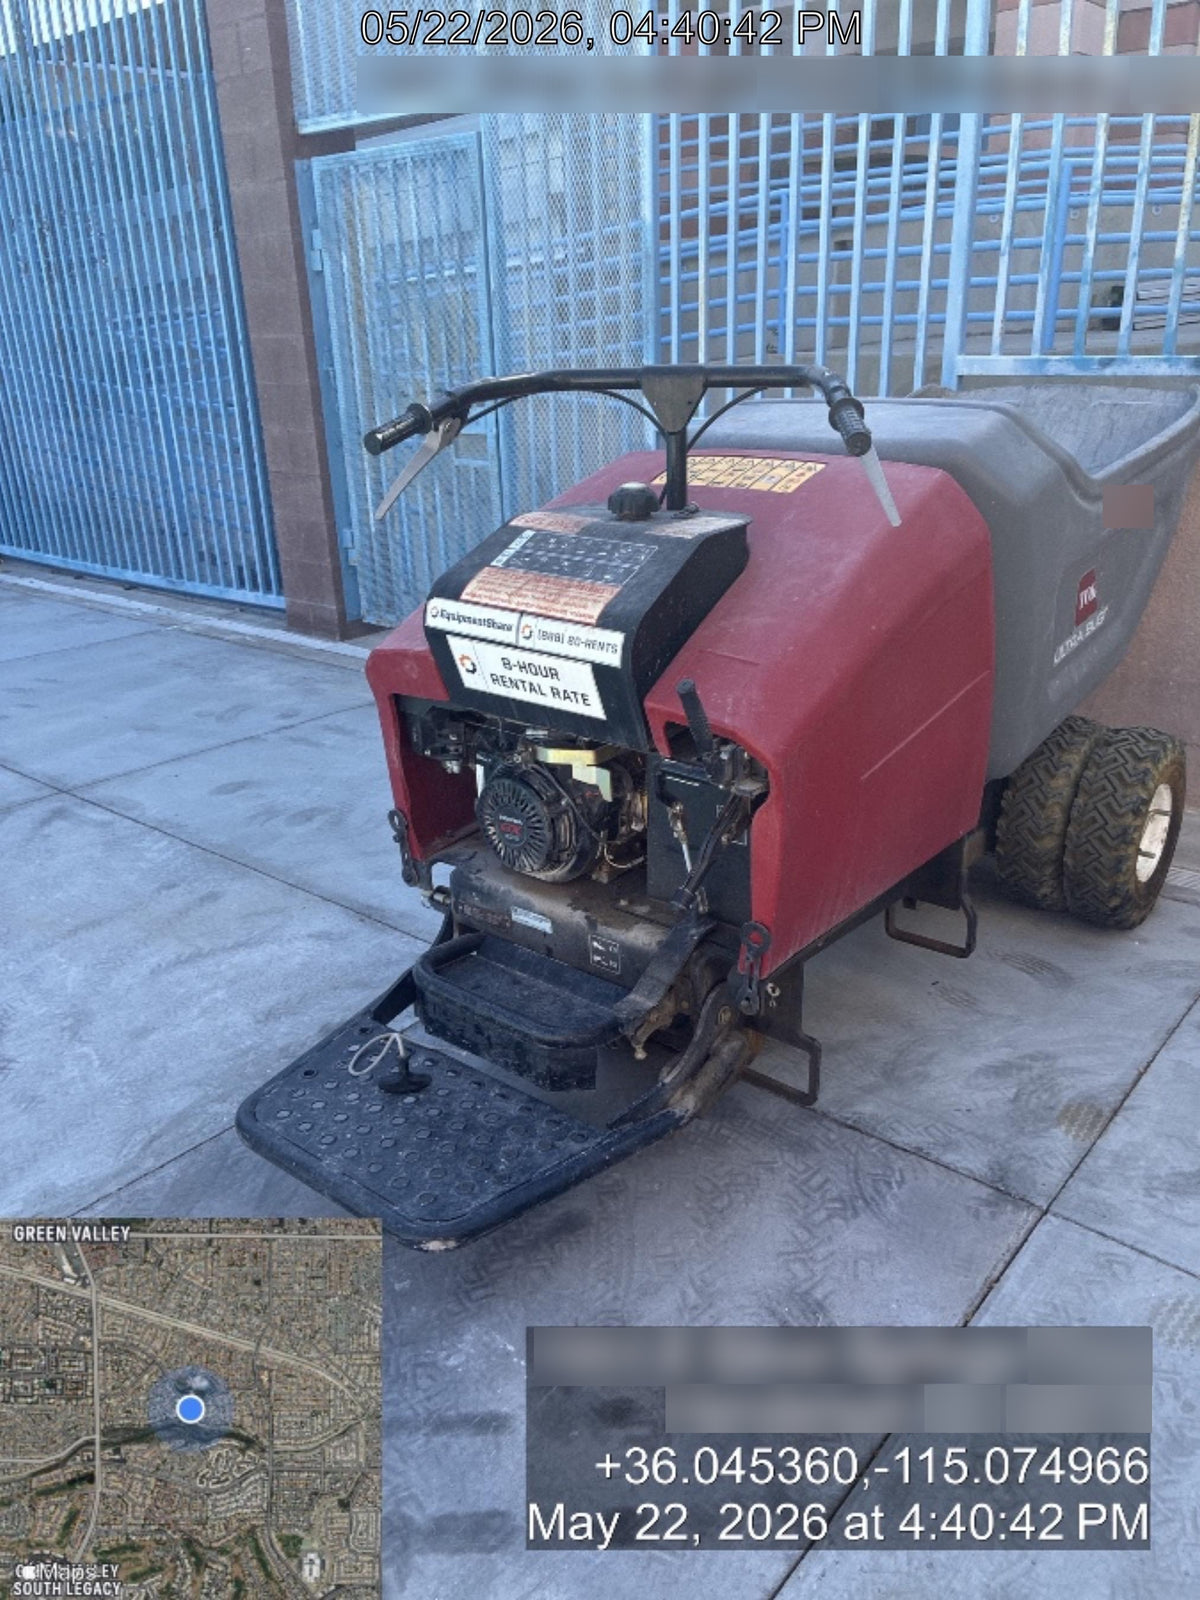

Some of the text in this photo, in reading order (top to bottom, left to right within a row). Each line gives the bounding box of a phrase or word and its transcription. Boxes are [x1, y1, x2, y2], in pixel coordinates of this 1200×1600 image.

[501, 657, 560, 681] 8-HOUR
[490, 673, 591, 706] RENTAL RATE
